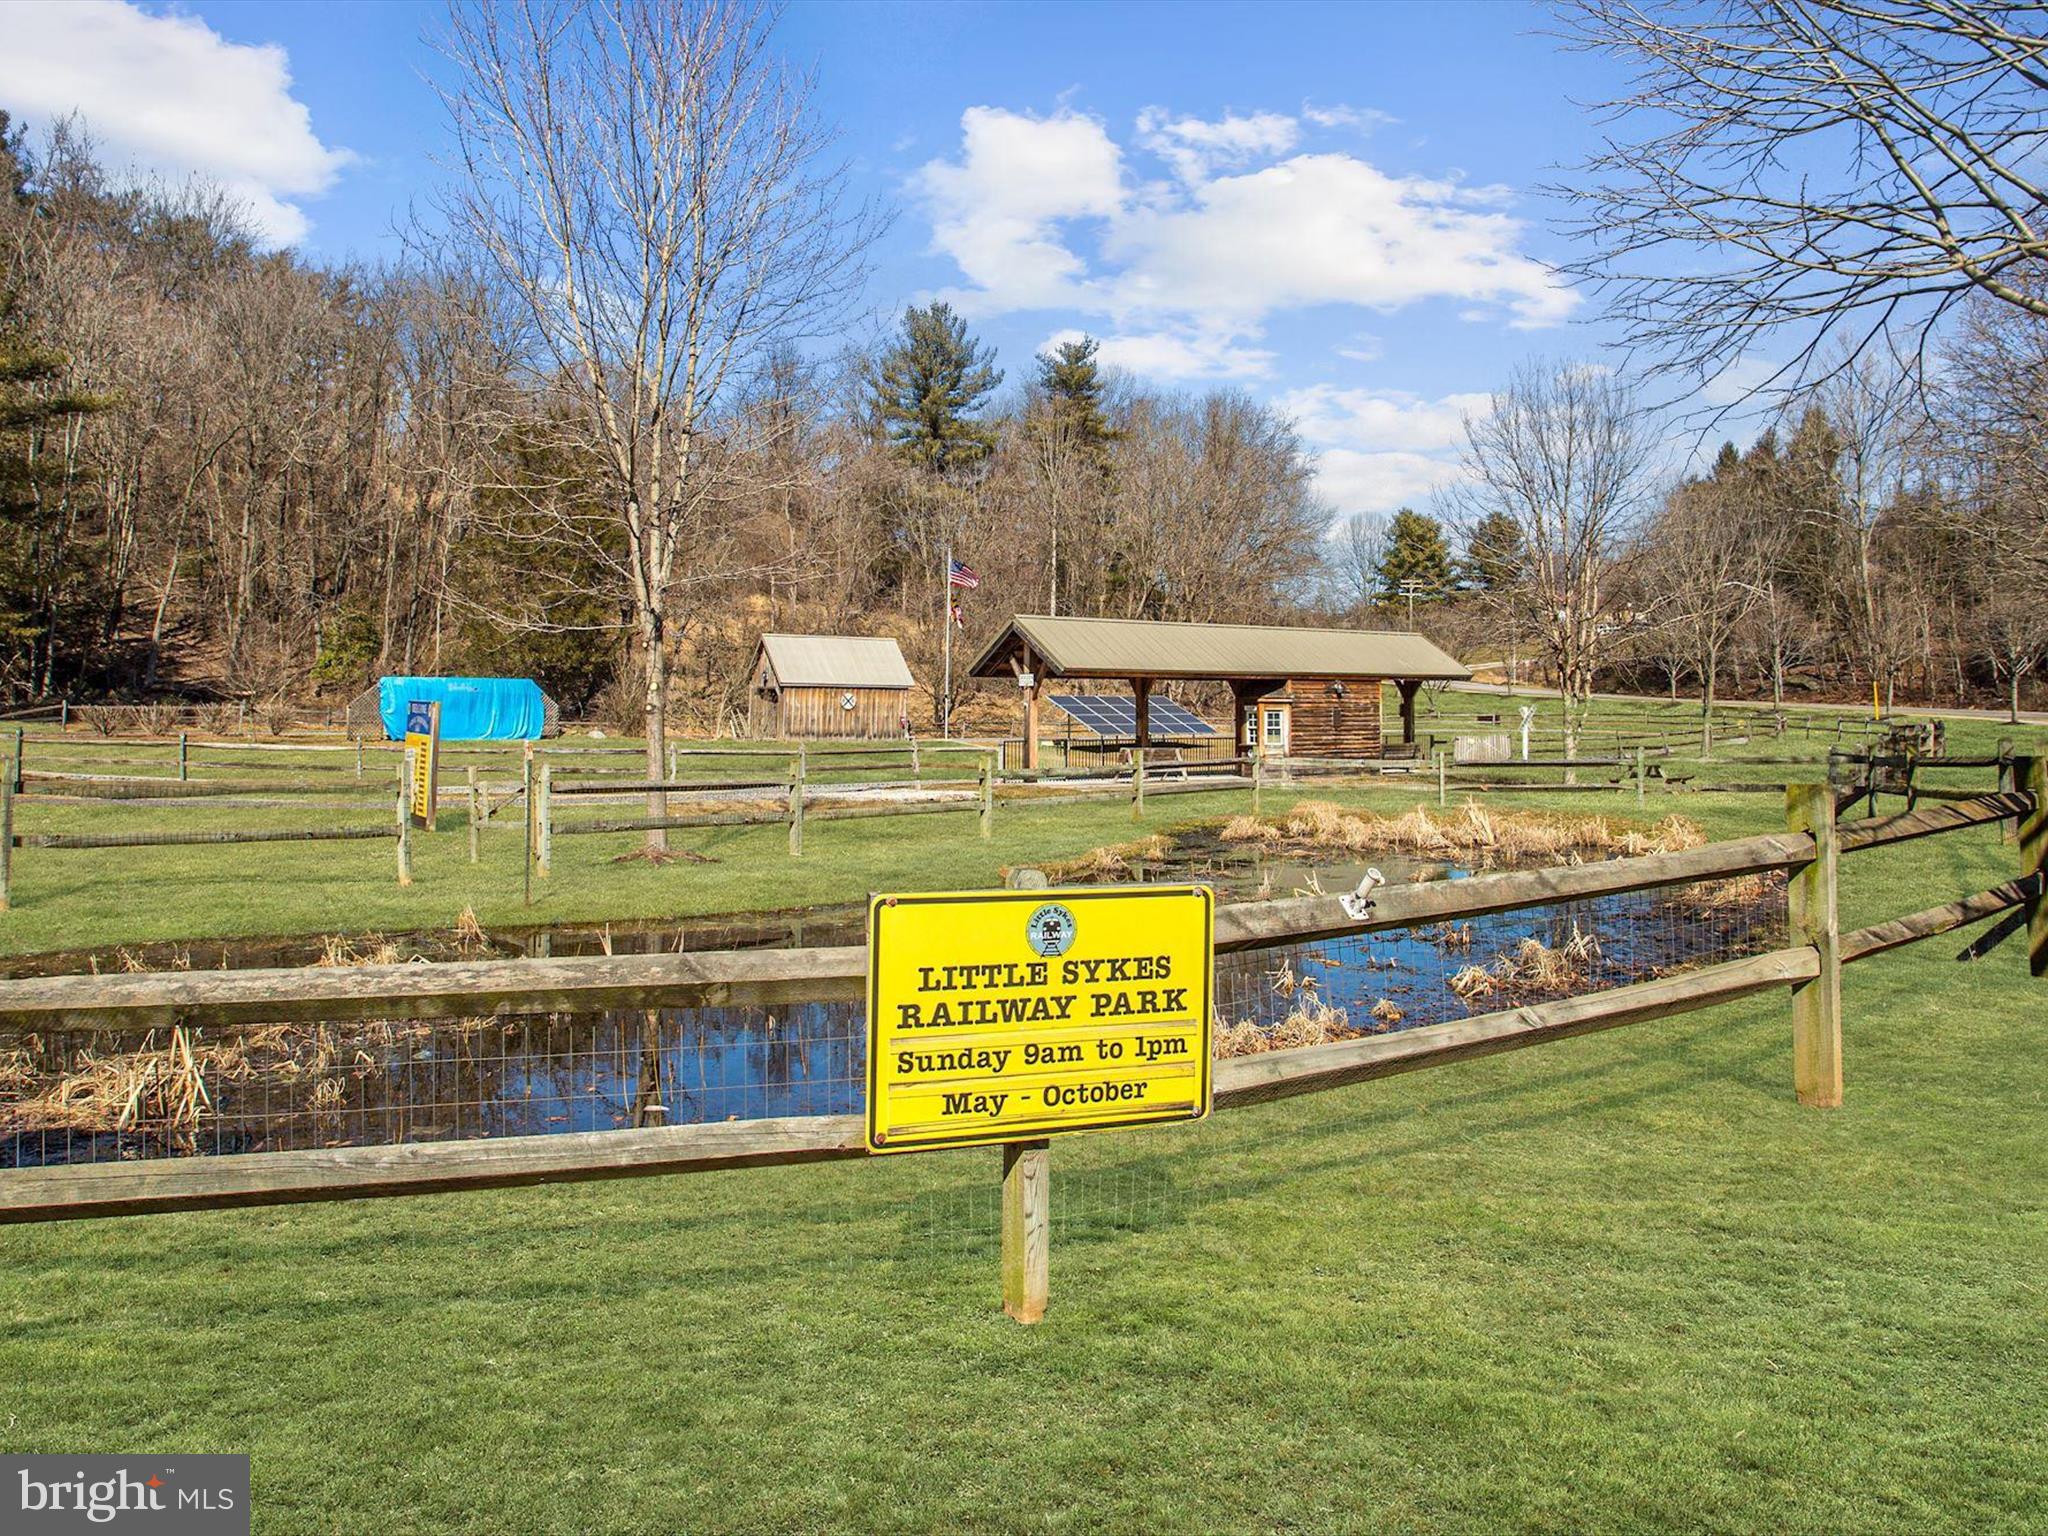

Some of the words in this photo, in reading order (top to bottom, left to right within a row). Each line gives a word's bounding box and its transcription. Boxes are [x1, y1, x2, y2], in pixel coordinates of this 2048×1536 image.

[1030, 931, 1072, 939] RAILWAY
[918, 962, 1048, 992] LITTLE
[1062, 955, 1171, 985] SYKES
[897, 995, 1077, 1029] RAILWAY
[1090, 988, 1188, 1018] PARK
[897, 1049, 1012, 1074] Sunday
[1024, 1043, 1084, 1065] 9am
[1096, 1039, 1123, 1060] to
[1135, 1036, 1188, 1061] 1pm
[941, 1092, 1008, 1116] May
[1043, 1081, 1148, 1107] October
